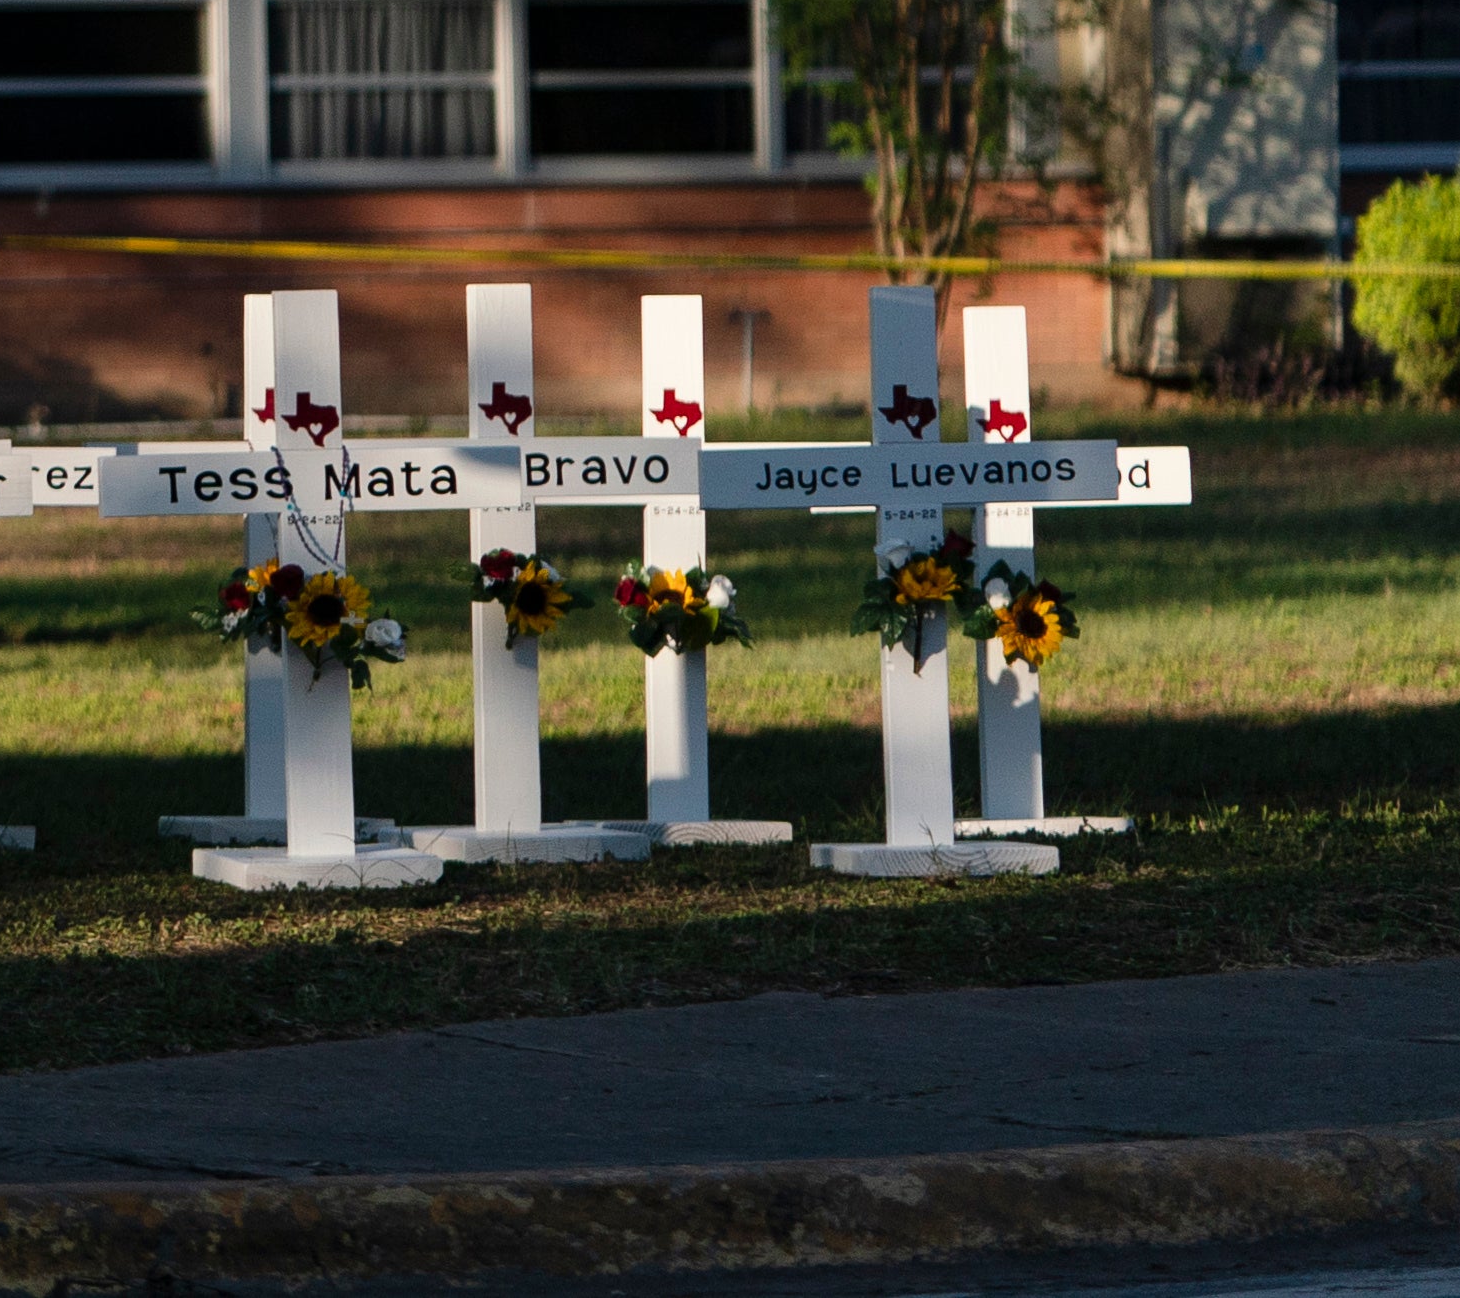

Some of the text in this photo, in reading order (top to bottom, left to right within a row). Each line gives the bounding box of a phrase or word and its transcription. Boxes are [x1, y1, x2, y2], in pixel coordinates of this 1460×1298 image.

[158, 461, 458, 503] Tess Mata
[525, 452, 670, 487] Bravo
[755, 458, 1076, 496] Jayce Luevanos
[884, 508, 937, 521] 5-24-22
